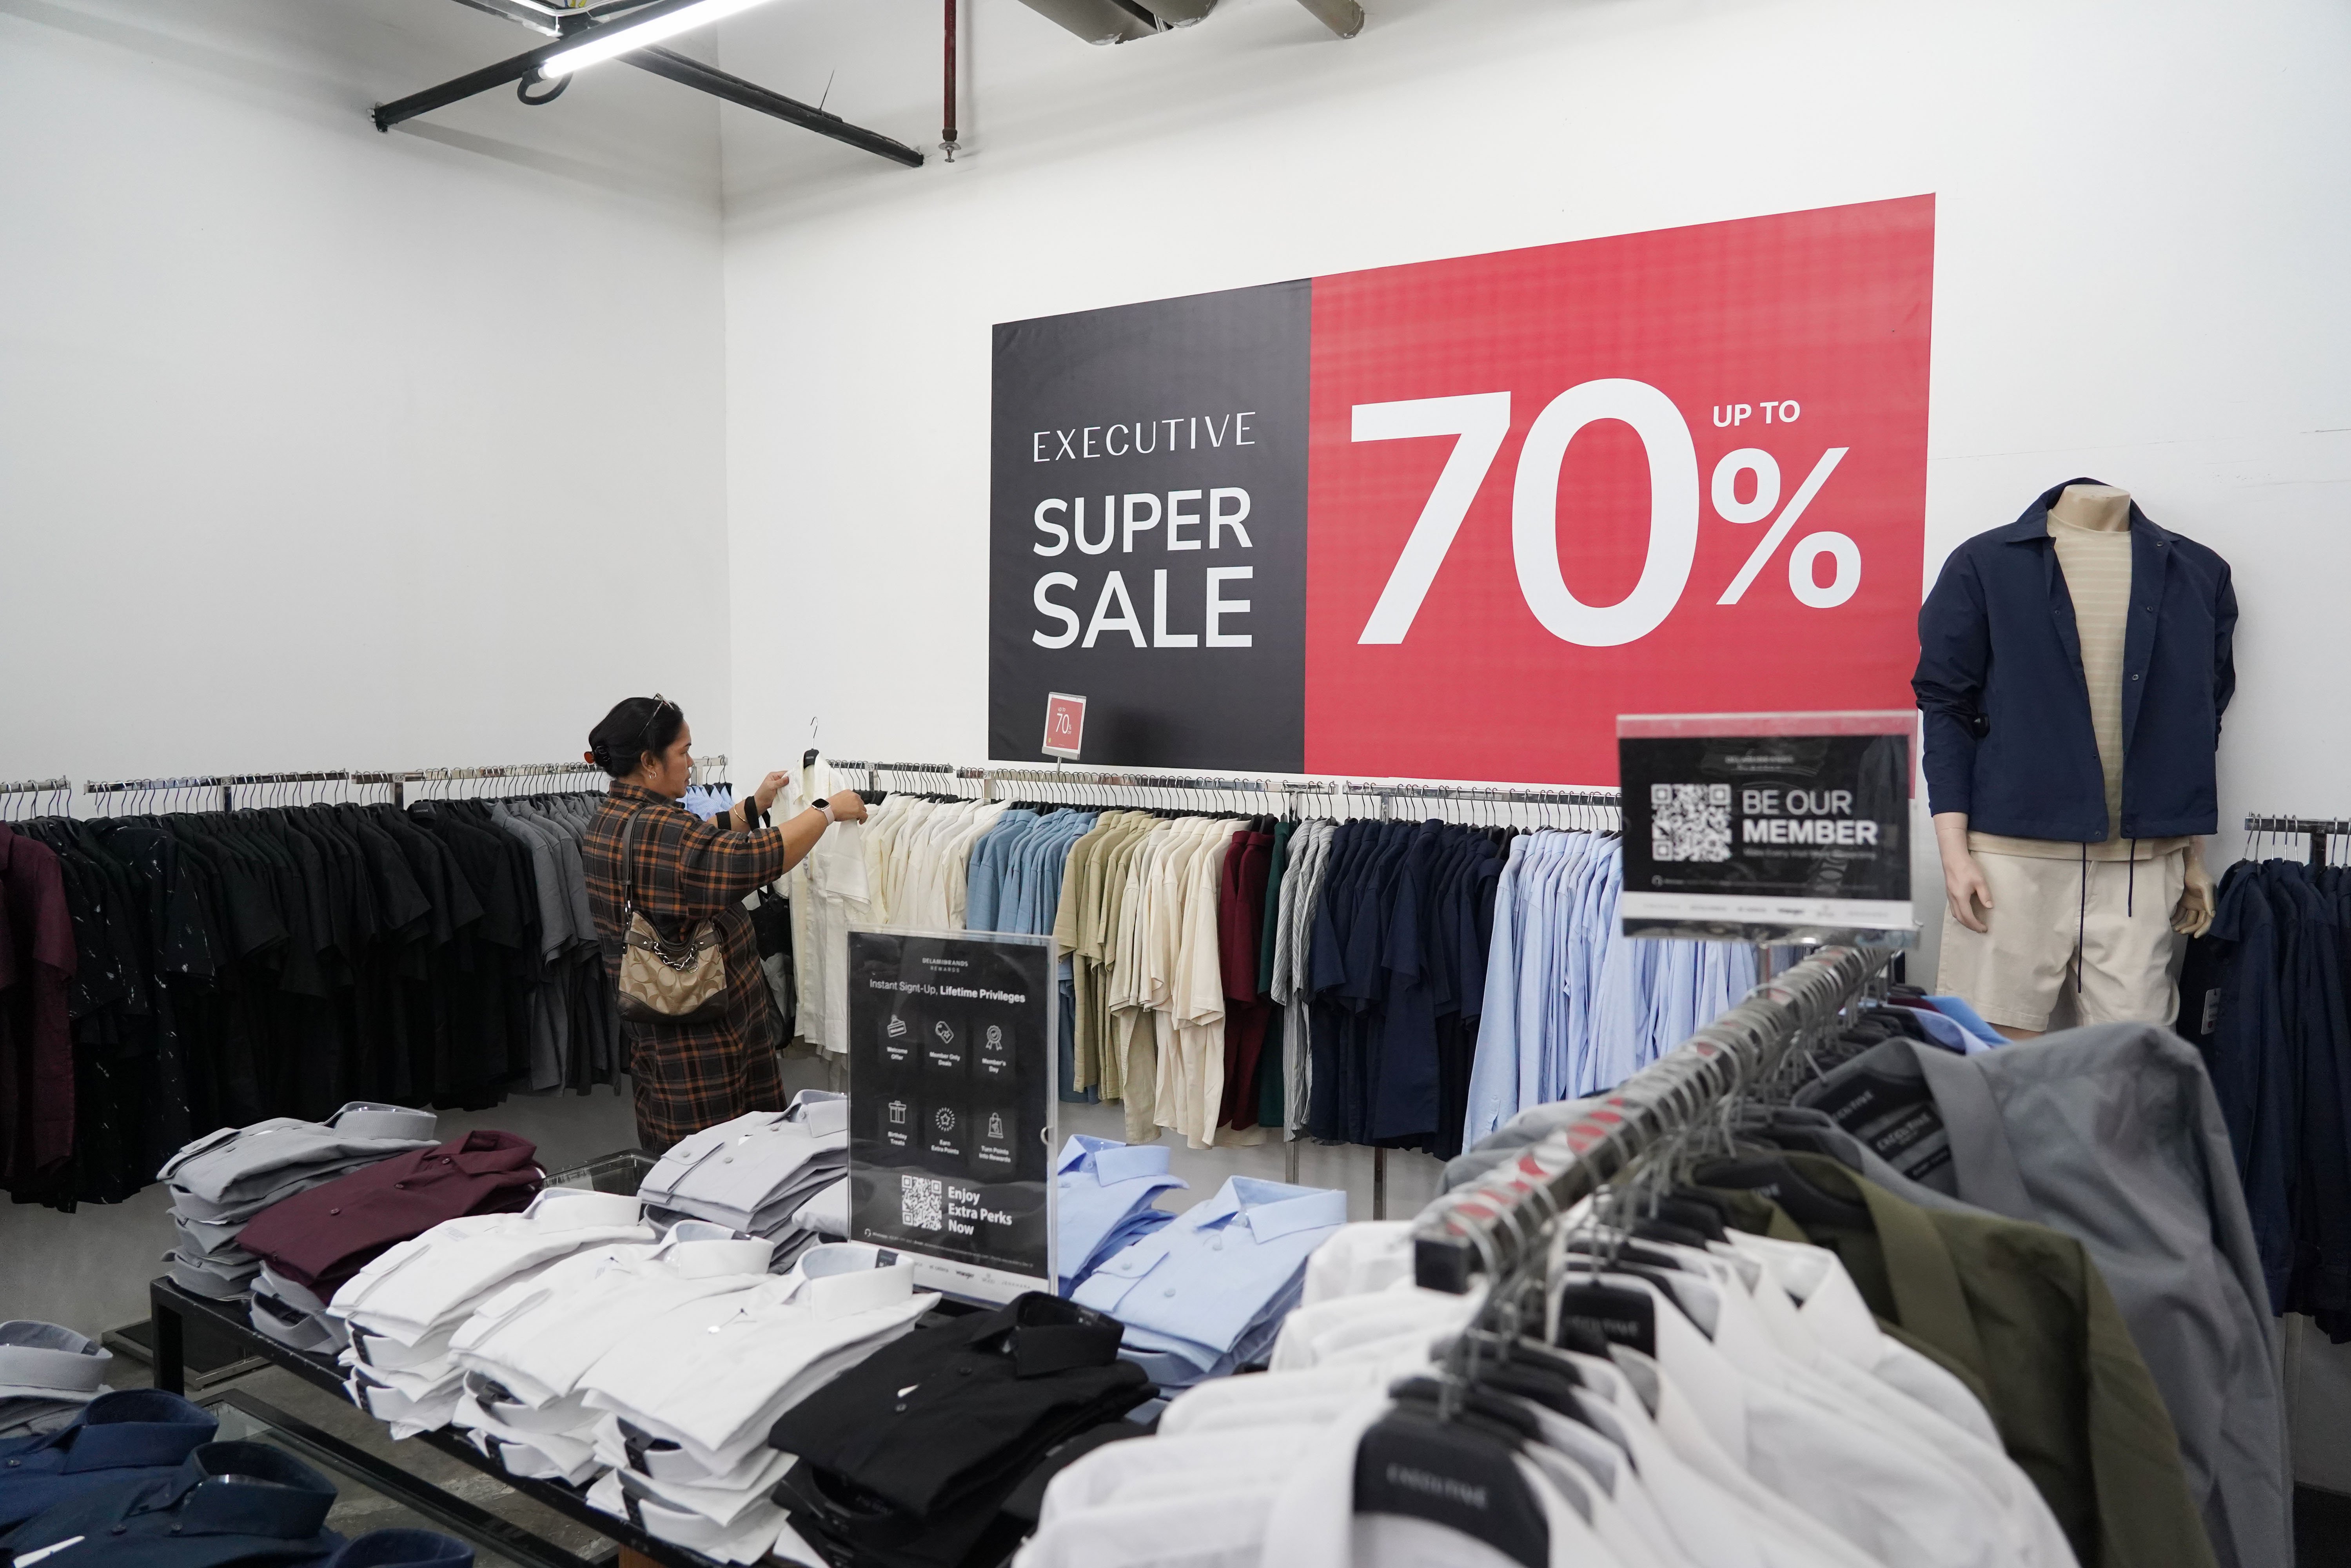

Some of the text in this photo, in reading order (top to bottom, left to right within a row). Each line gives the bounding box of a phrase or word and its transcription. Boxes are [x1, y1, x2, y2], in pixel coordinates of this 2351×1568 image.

[1712, 400, 1801, 427] UP TO
[1033, 412, 1256, 462] EXECUTIVE
[1033, 487, 1253, 557] SUPER
[1351, 377, 1862, 647] 70%
[1032, 566, 1253, 649] SALE
[1742, 789, 1853, 815] BE OUR
[1742, 819, 1879, 846] MEMBER
[869, 978, 1026, 1004] Instant Signt-Up, Lifetime Privileges
[948, 1186, 980, 1206] Enjoy
[948, 1203, 1013, 1226] Extra Perks
[948, 1218, 975, 1236] Now
